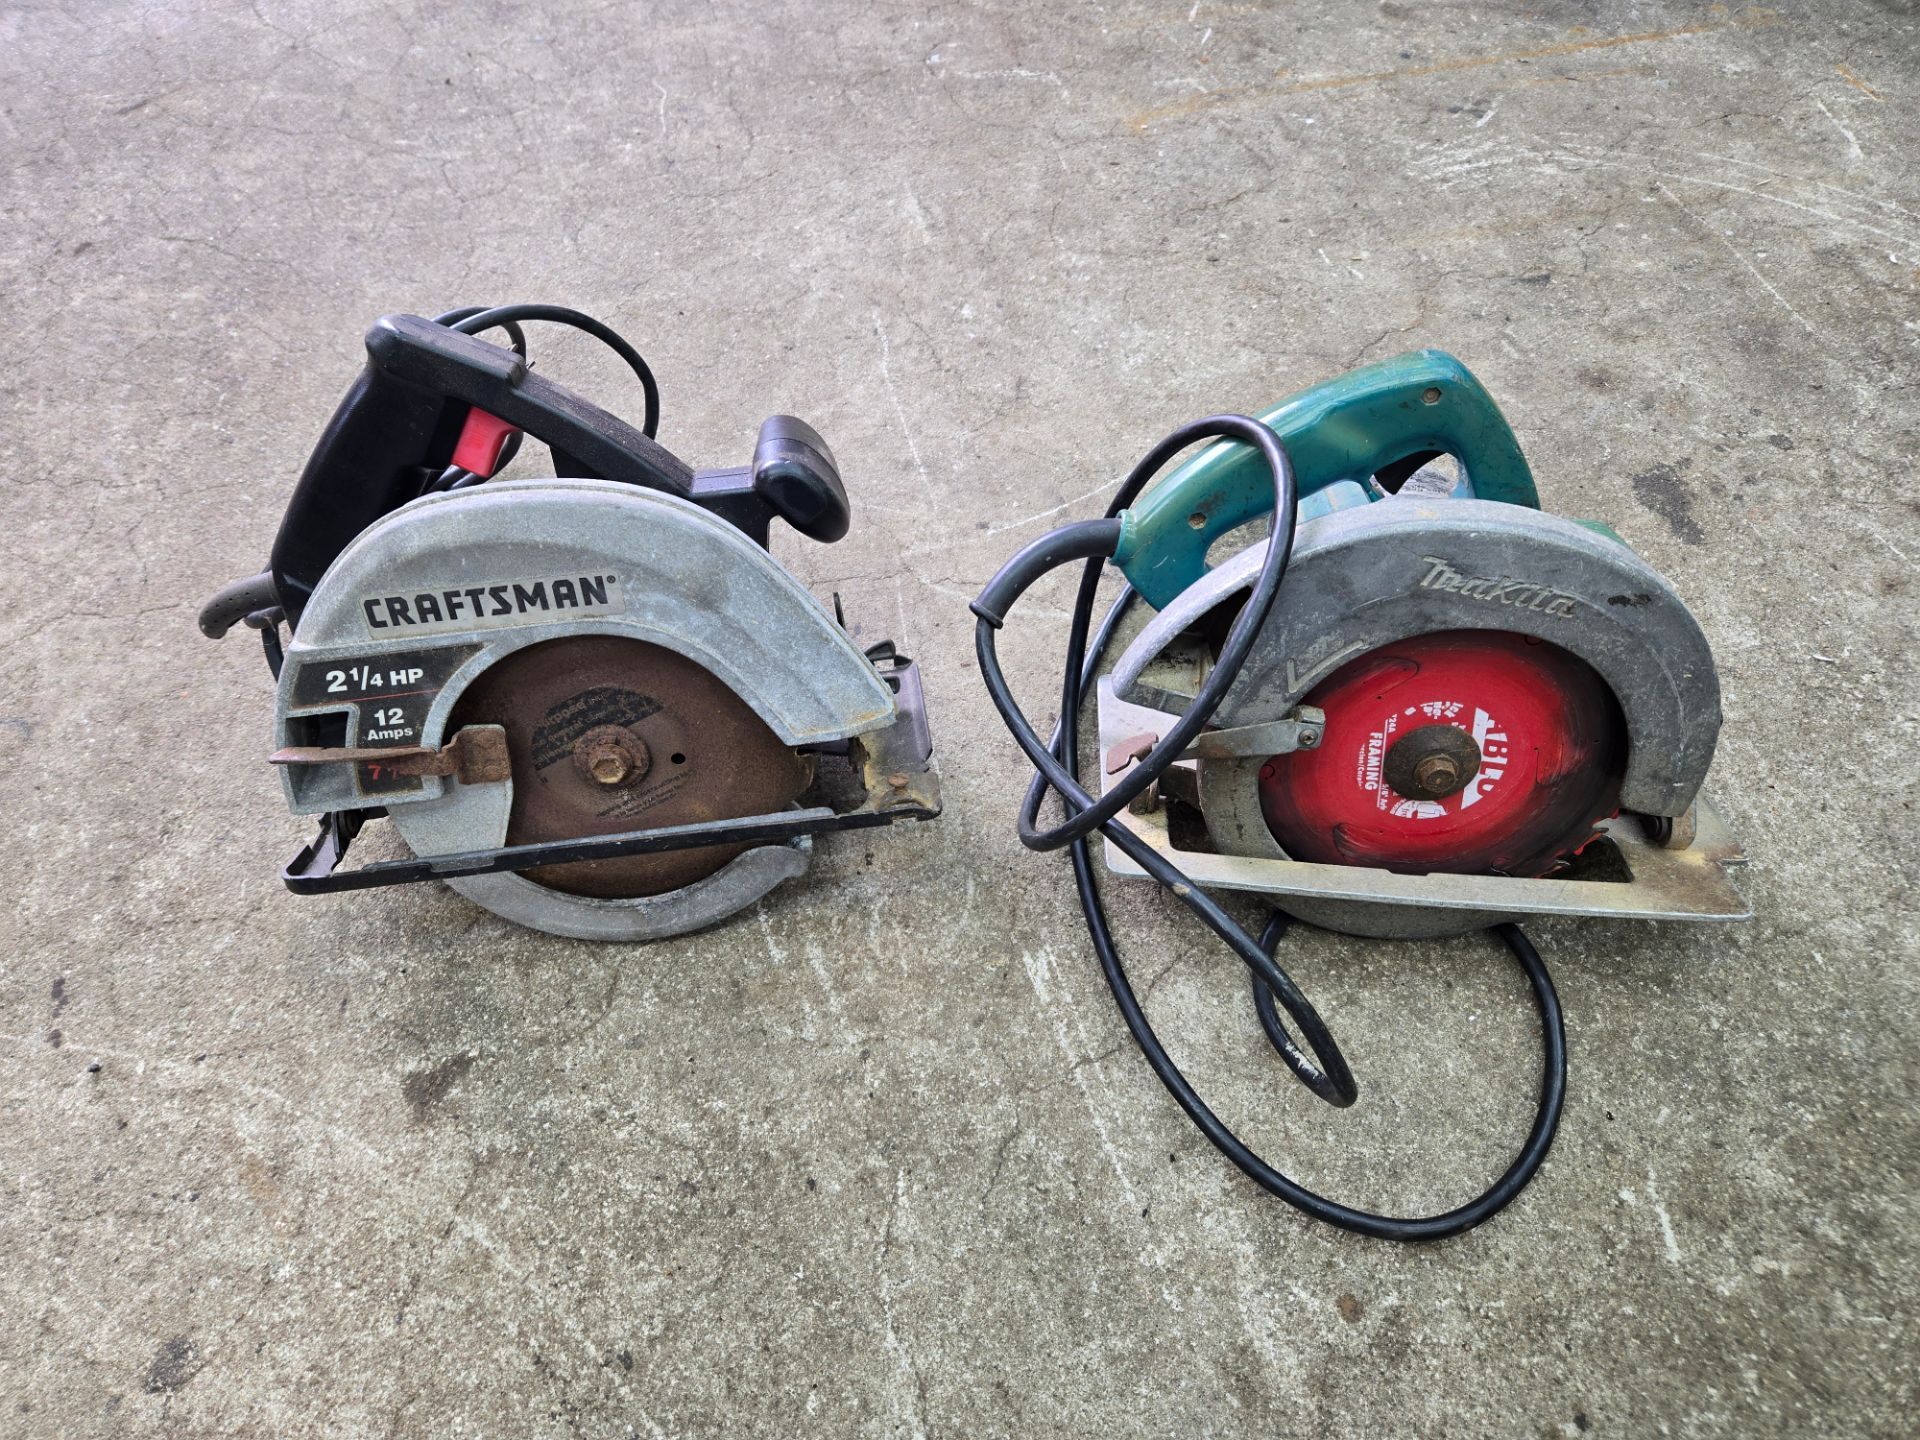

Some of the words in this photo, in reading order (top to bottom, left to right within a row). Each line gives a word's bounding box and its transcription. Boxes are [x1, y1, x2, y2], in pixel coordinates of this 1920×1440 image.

[389, 668, 424, 686] HP
[373, 707, 405, 727] 12
[367, 727, 414, 741] Amps
[1364, 732, 1383, 791] FRAMING
